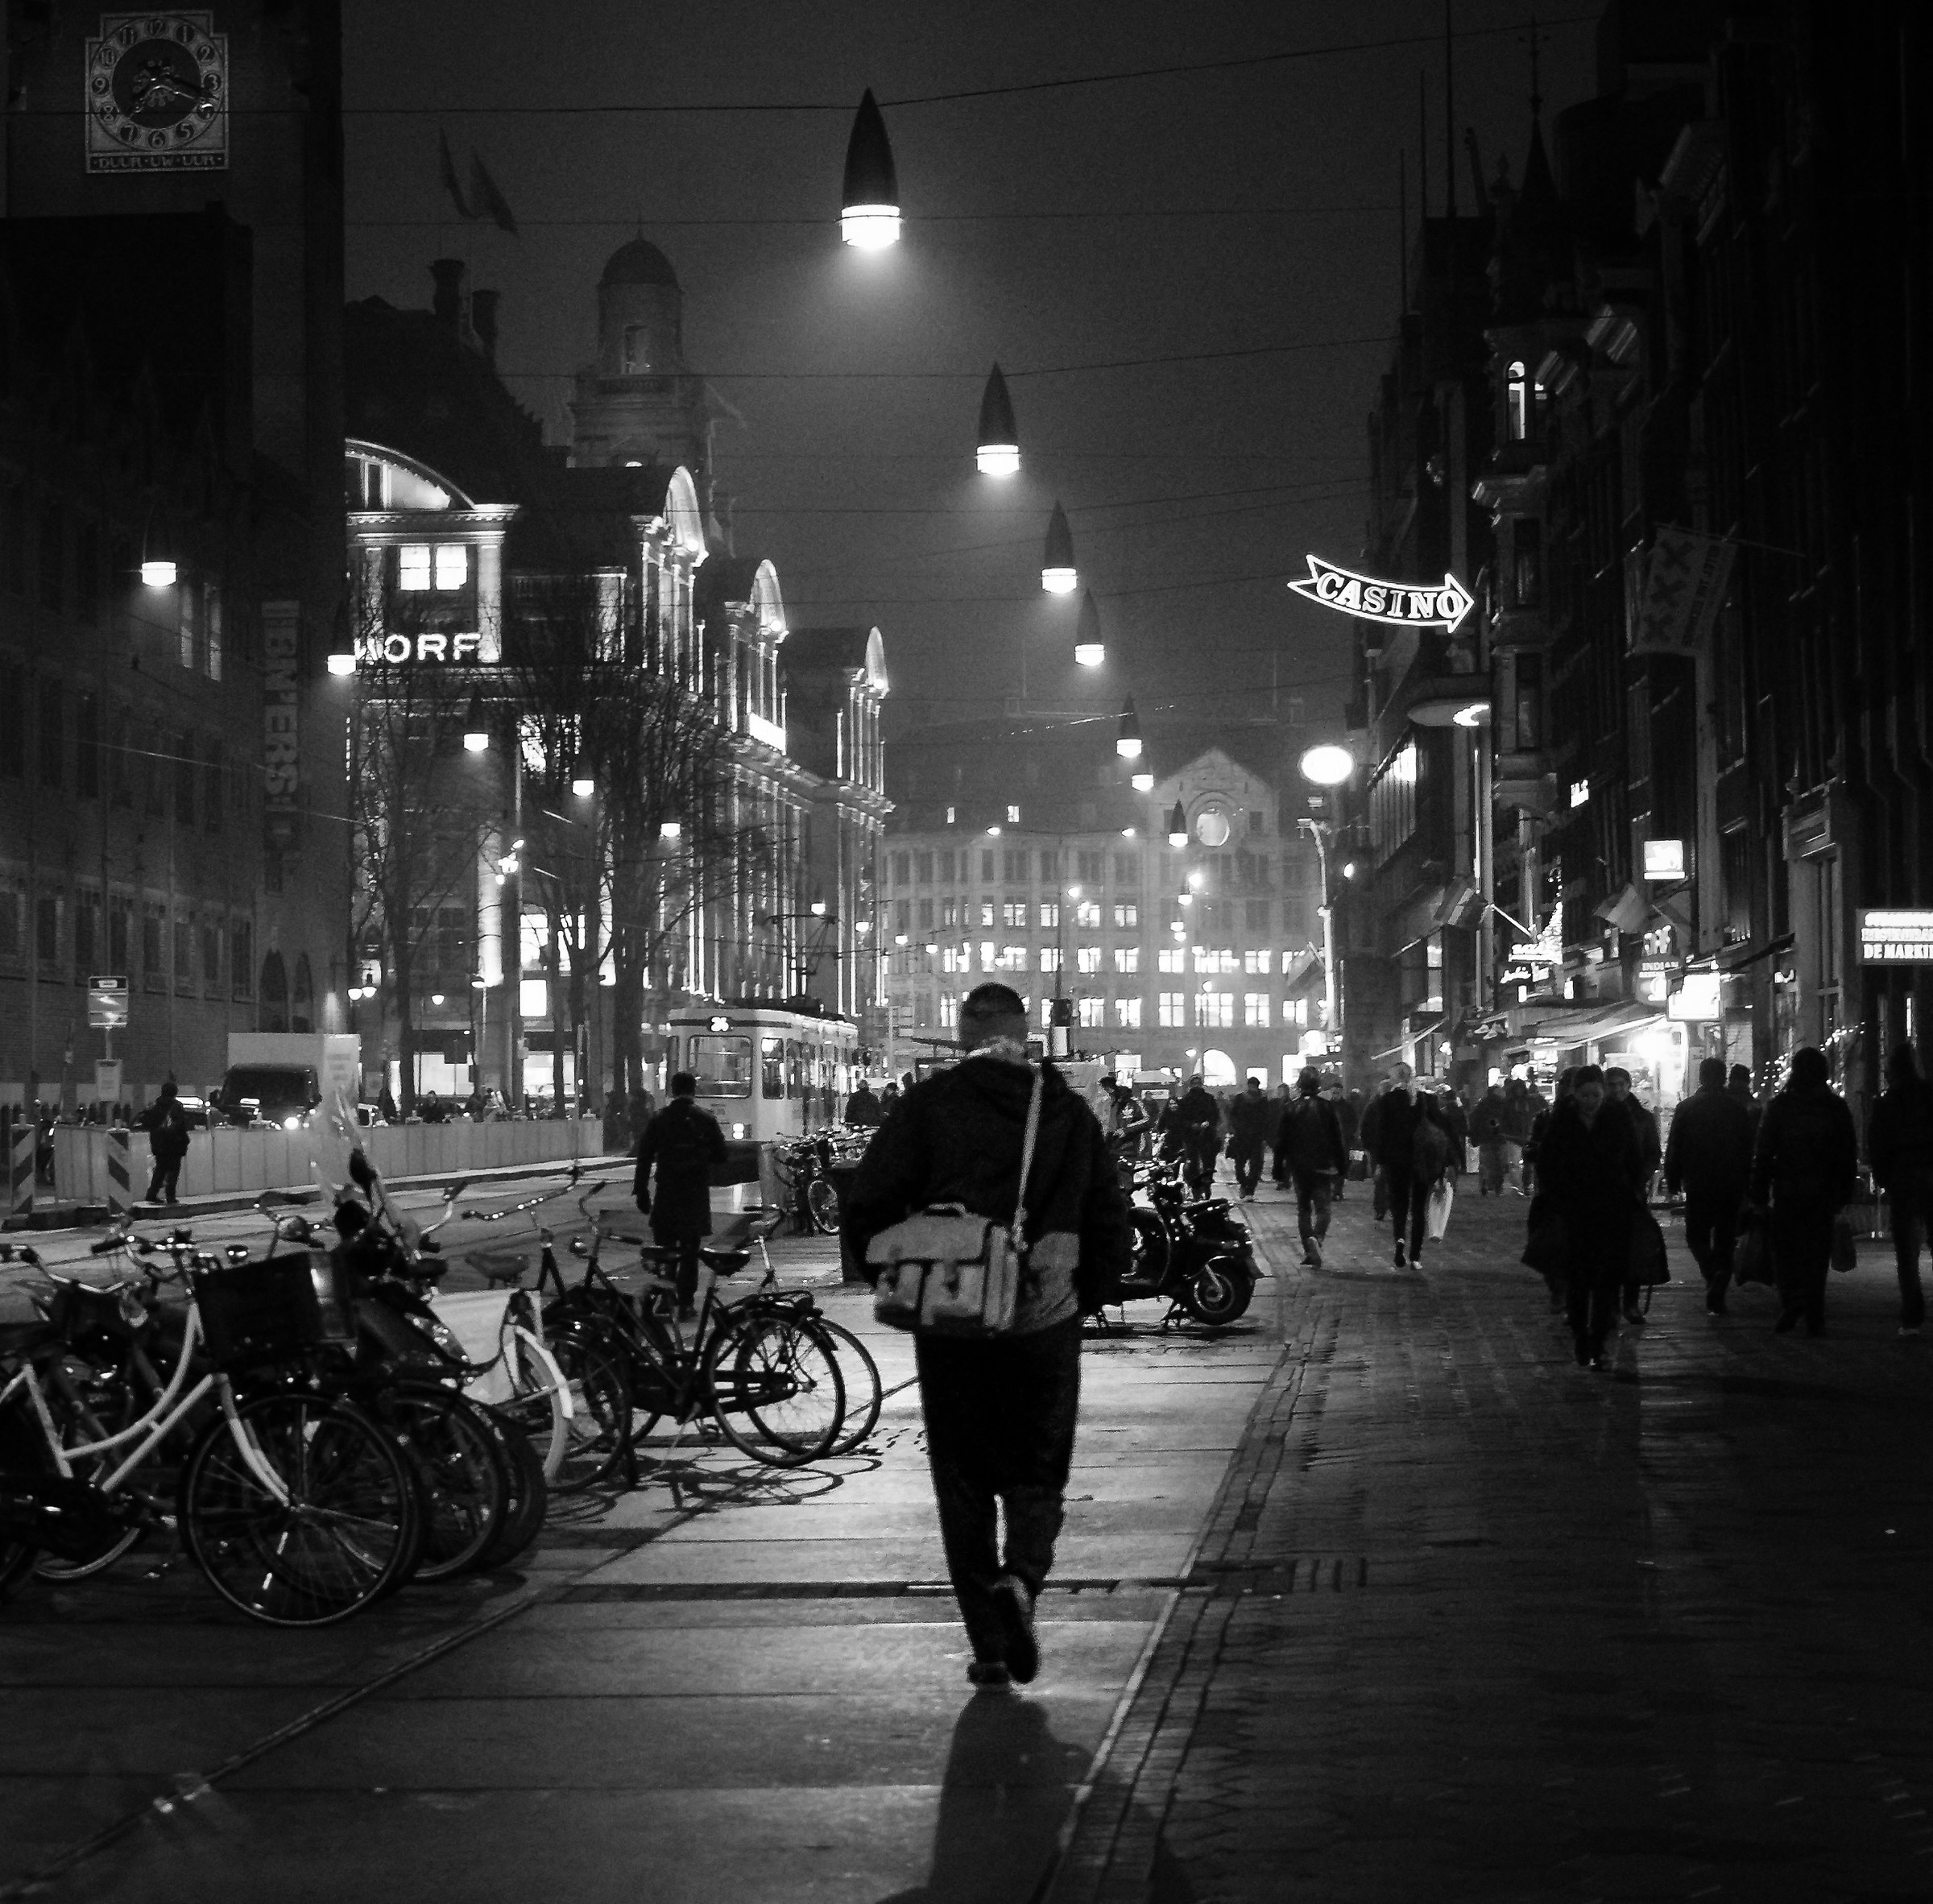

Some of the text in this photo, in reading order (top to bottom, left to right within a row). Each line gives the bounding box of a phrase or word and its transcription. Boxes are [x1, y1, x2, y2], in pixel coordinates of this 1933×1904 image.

[101, 48, 115, 67] 10
[200, 47, 211, 62] 2
[96, 78, 106, 94] 9
[207, 74, 218, 91] 3
[103, 106, 114, 122] 8
[125, 124, 135, 143] 7
[181, 124, 192, 139] 5
[152, 134, 164, 148] 6
[1316, 572, 1465, 619] CASINO
[1863, 944, 1883, 959] DE
